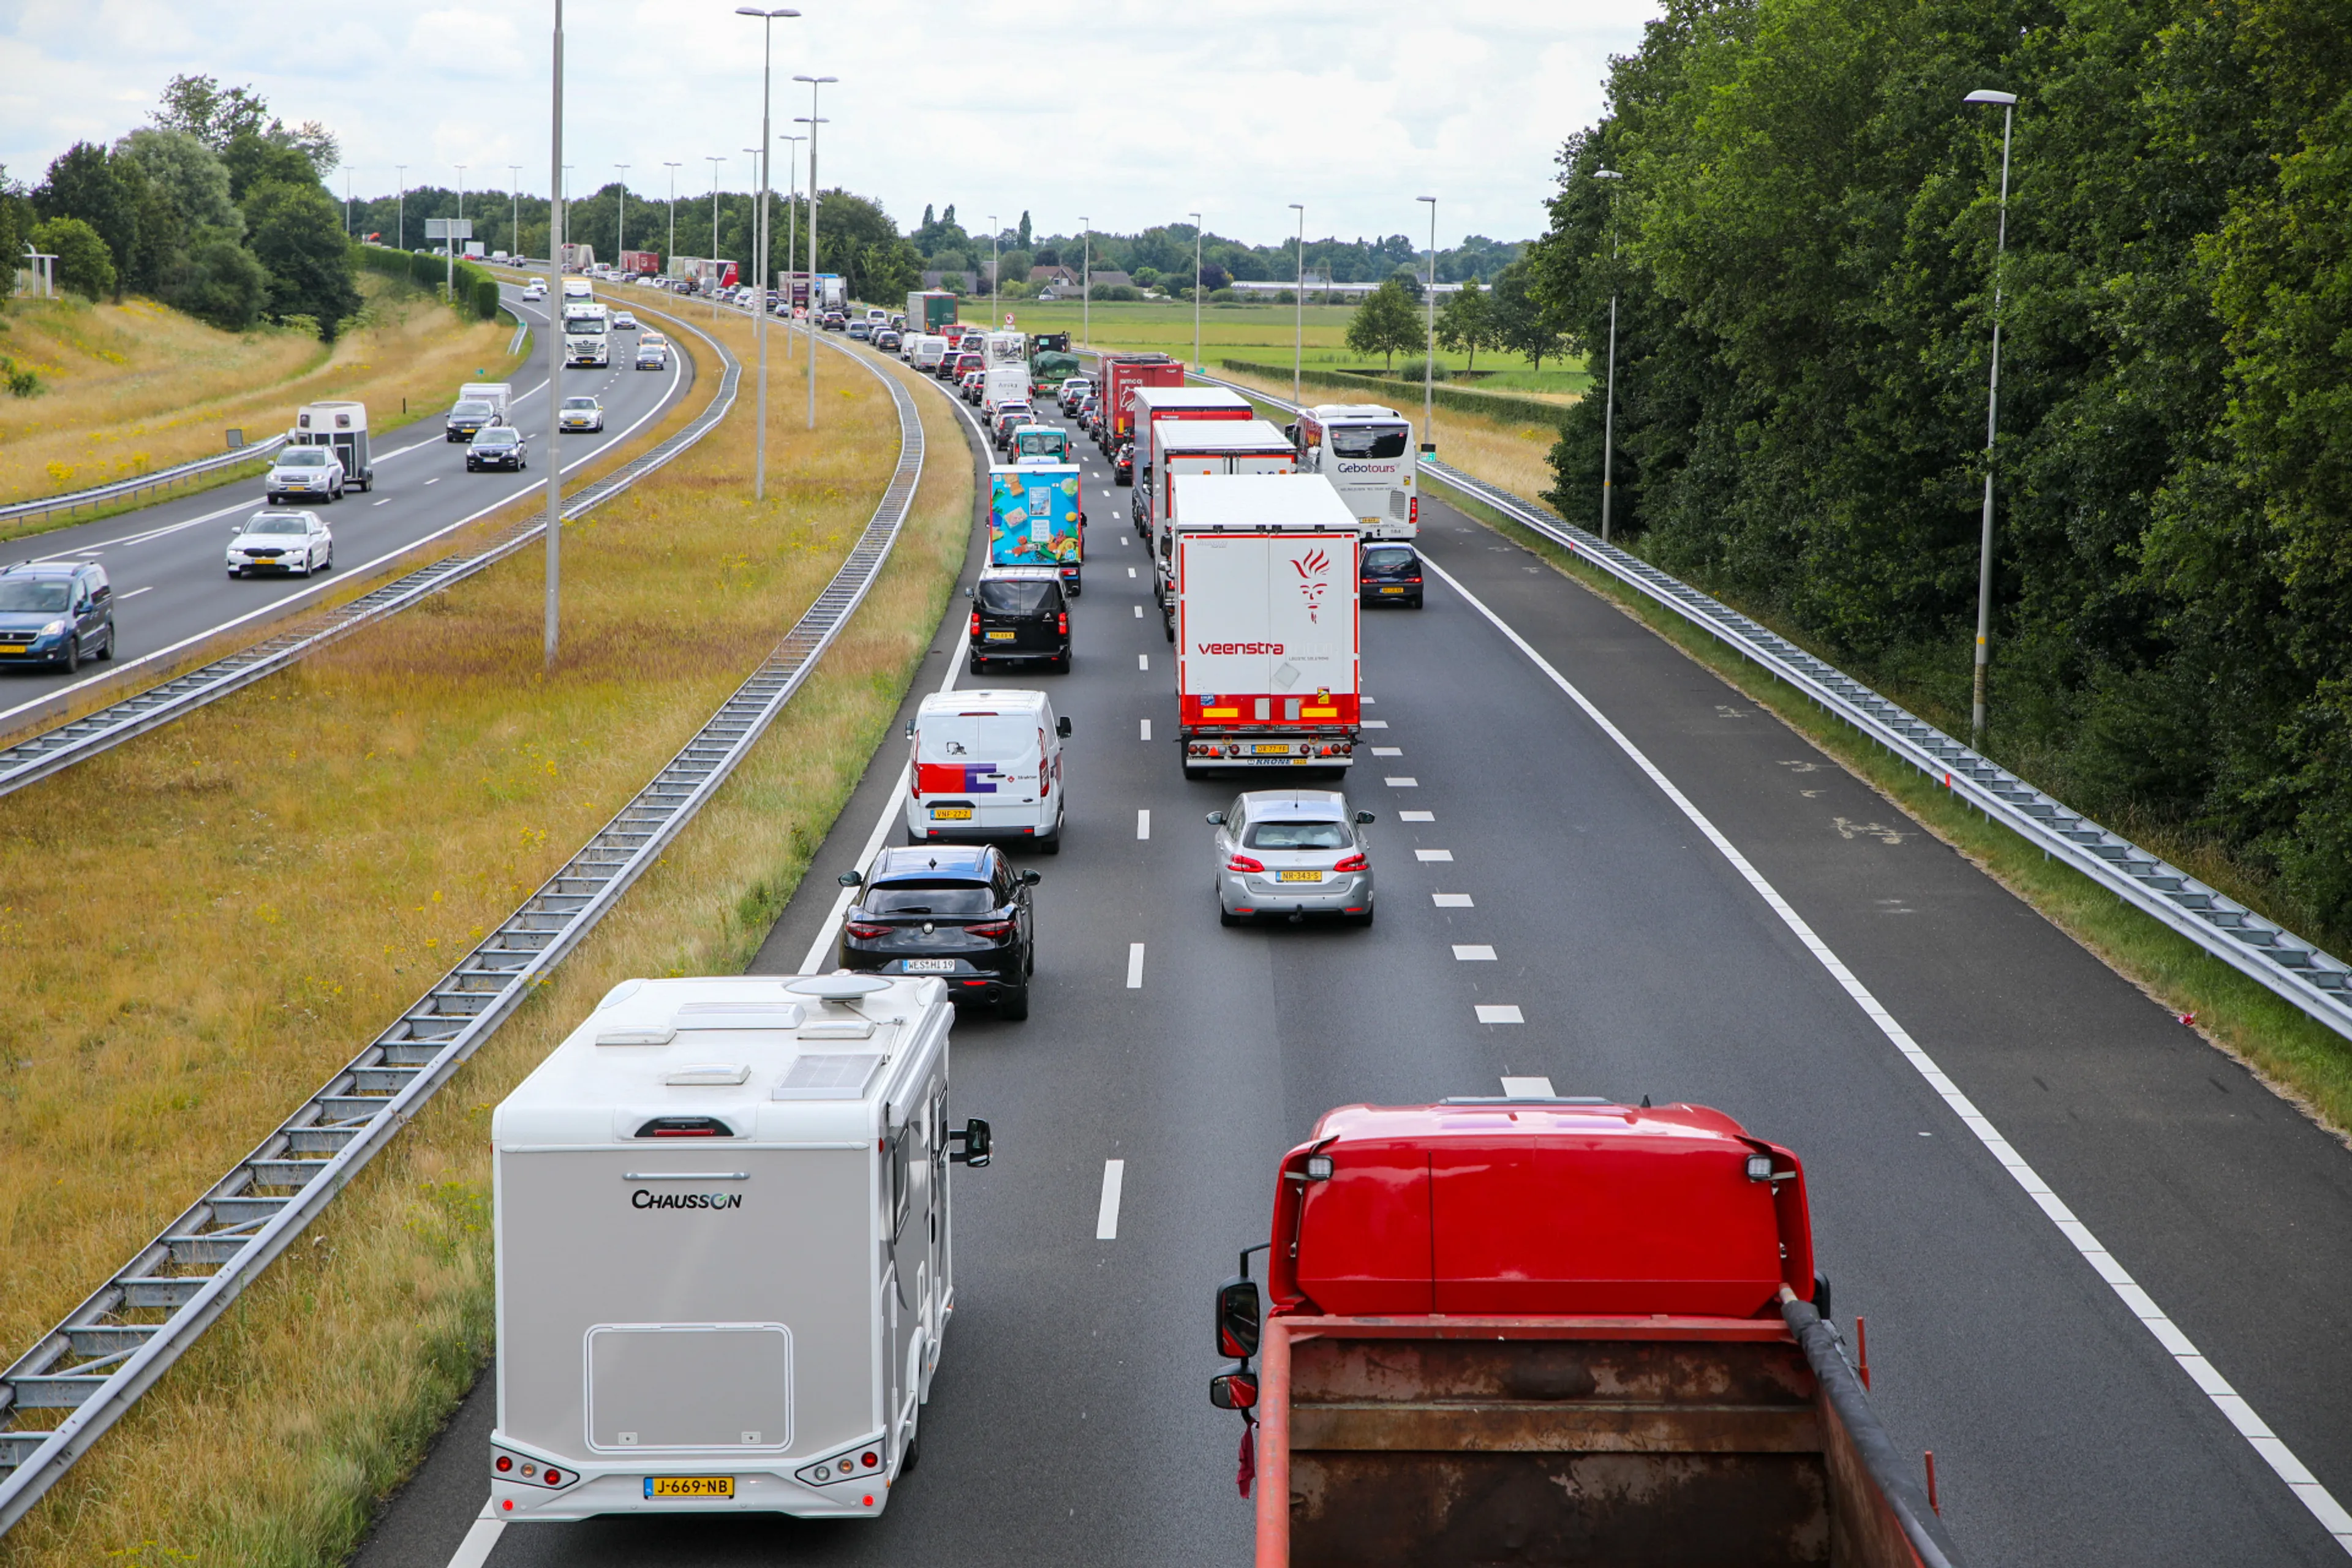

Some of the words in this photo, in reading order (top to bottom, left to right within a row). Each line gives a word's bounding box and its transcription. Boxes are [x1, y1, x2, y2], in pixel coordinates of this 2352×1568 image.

[1338, 463, 1395, 473] Gebotours
[1198, 642, 1284, 655] veenstra
[909, 962, 925, 970] WES
[631, 1189, 742, 1210] CHAUSSON
[658, 1480, 728, 1493] J-669-NB
